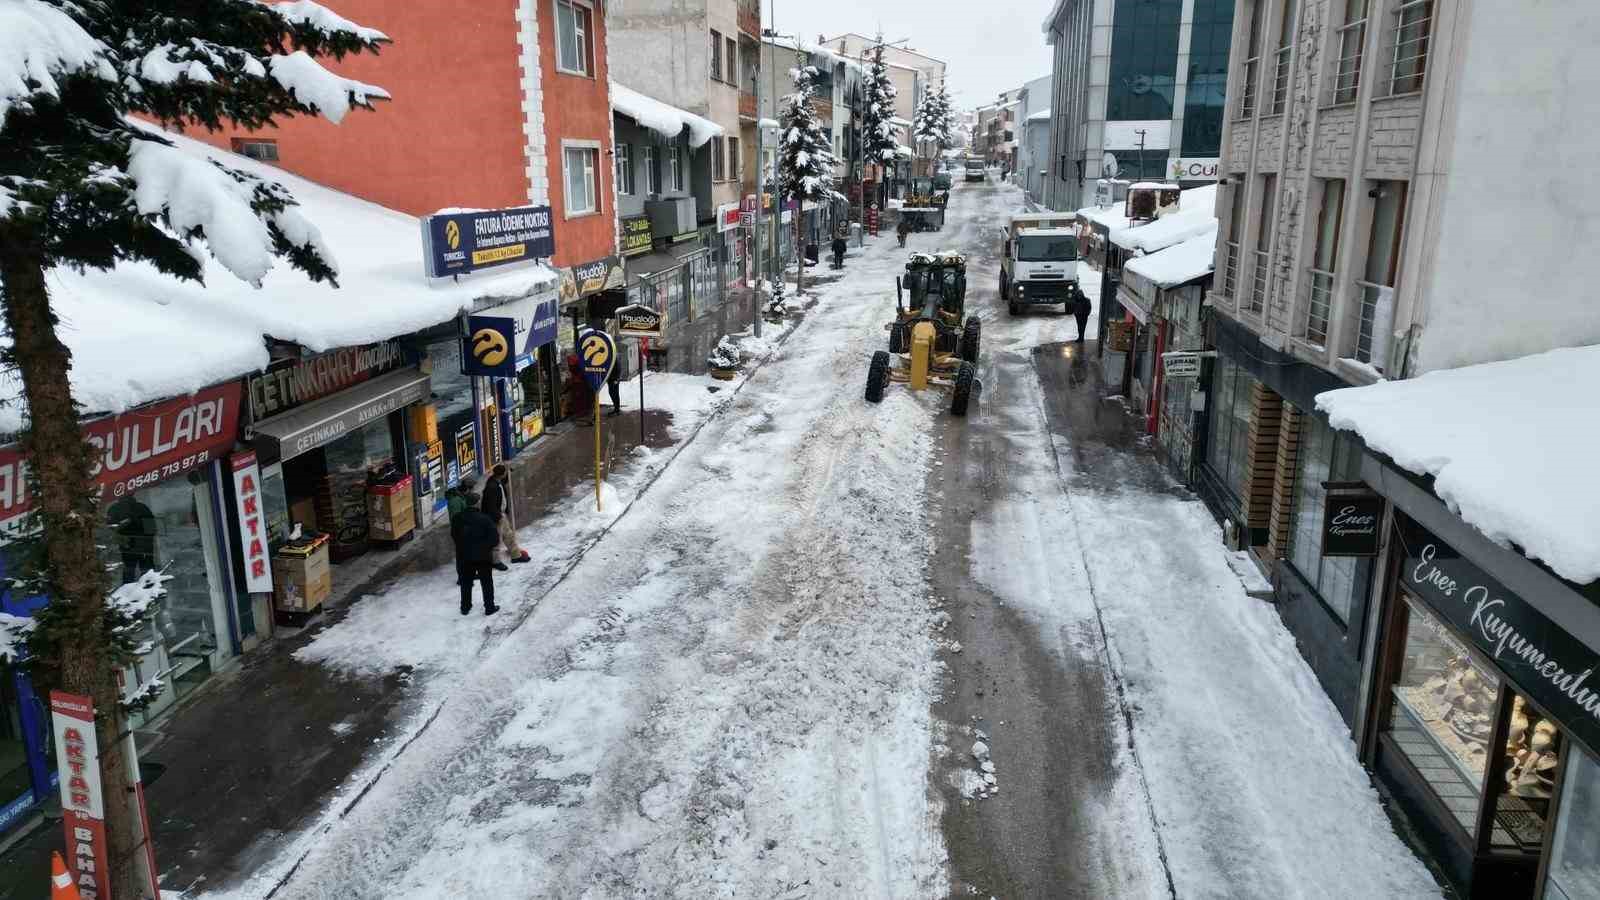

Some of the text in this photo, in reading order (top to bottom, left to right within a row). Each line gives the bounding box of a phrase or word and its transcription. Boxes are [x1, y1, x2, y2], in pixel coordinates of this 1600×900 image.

[475, 217, 502, 235] FATURA
[127, 450, 209, 491] 0546 713 97 21
[240, 473, 267, 578] AKTAR
[1331, 505, 1375, 525] Enes
[1414, 544, 1458, 596] Enes
[64, 727, 90, 806] AKTAR
